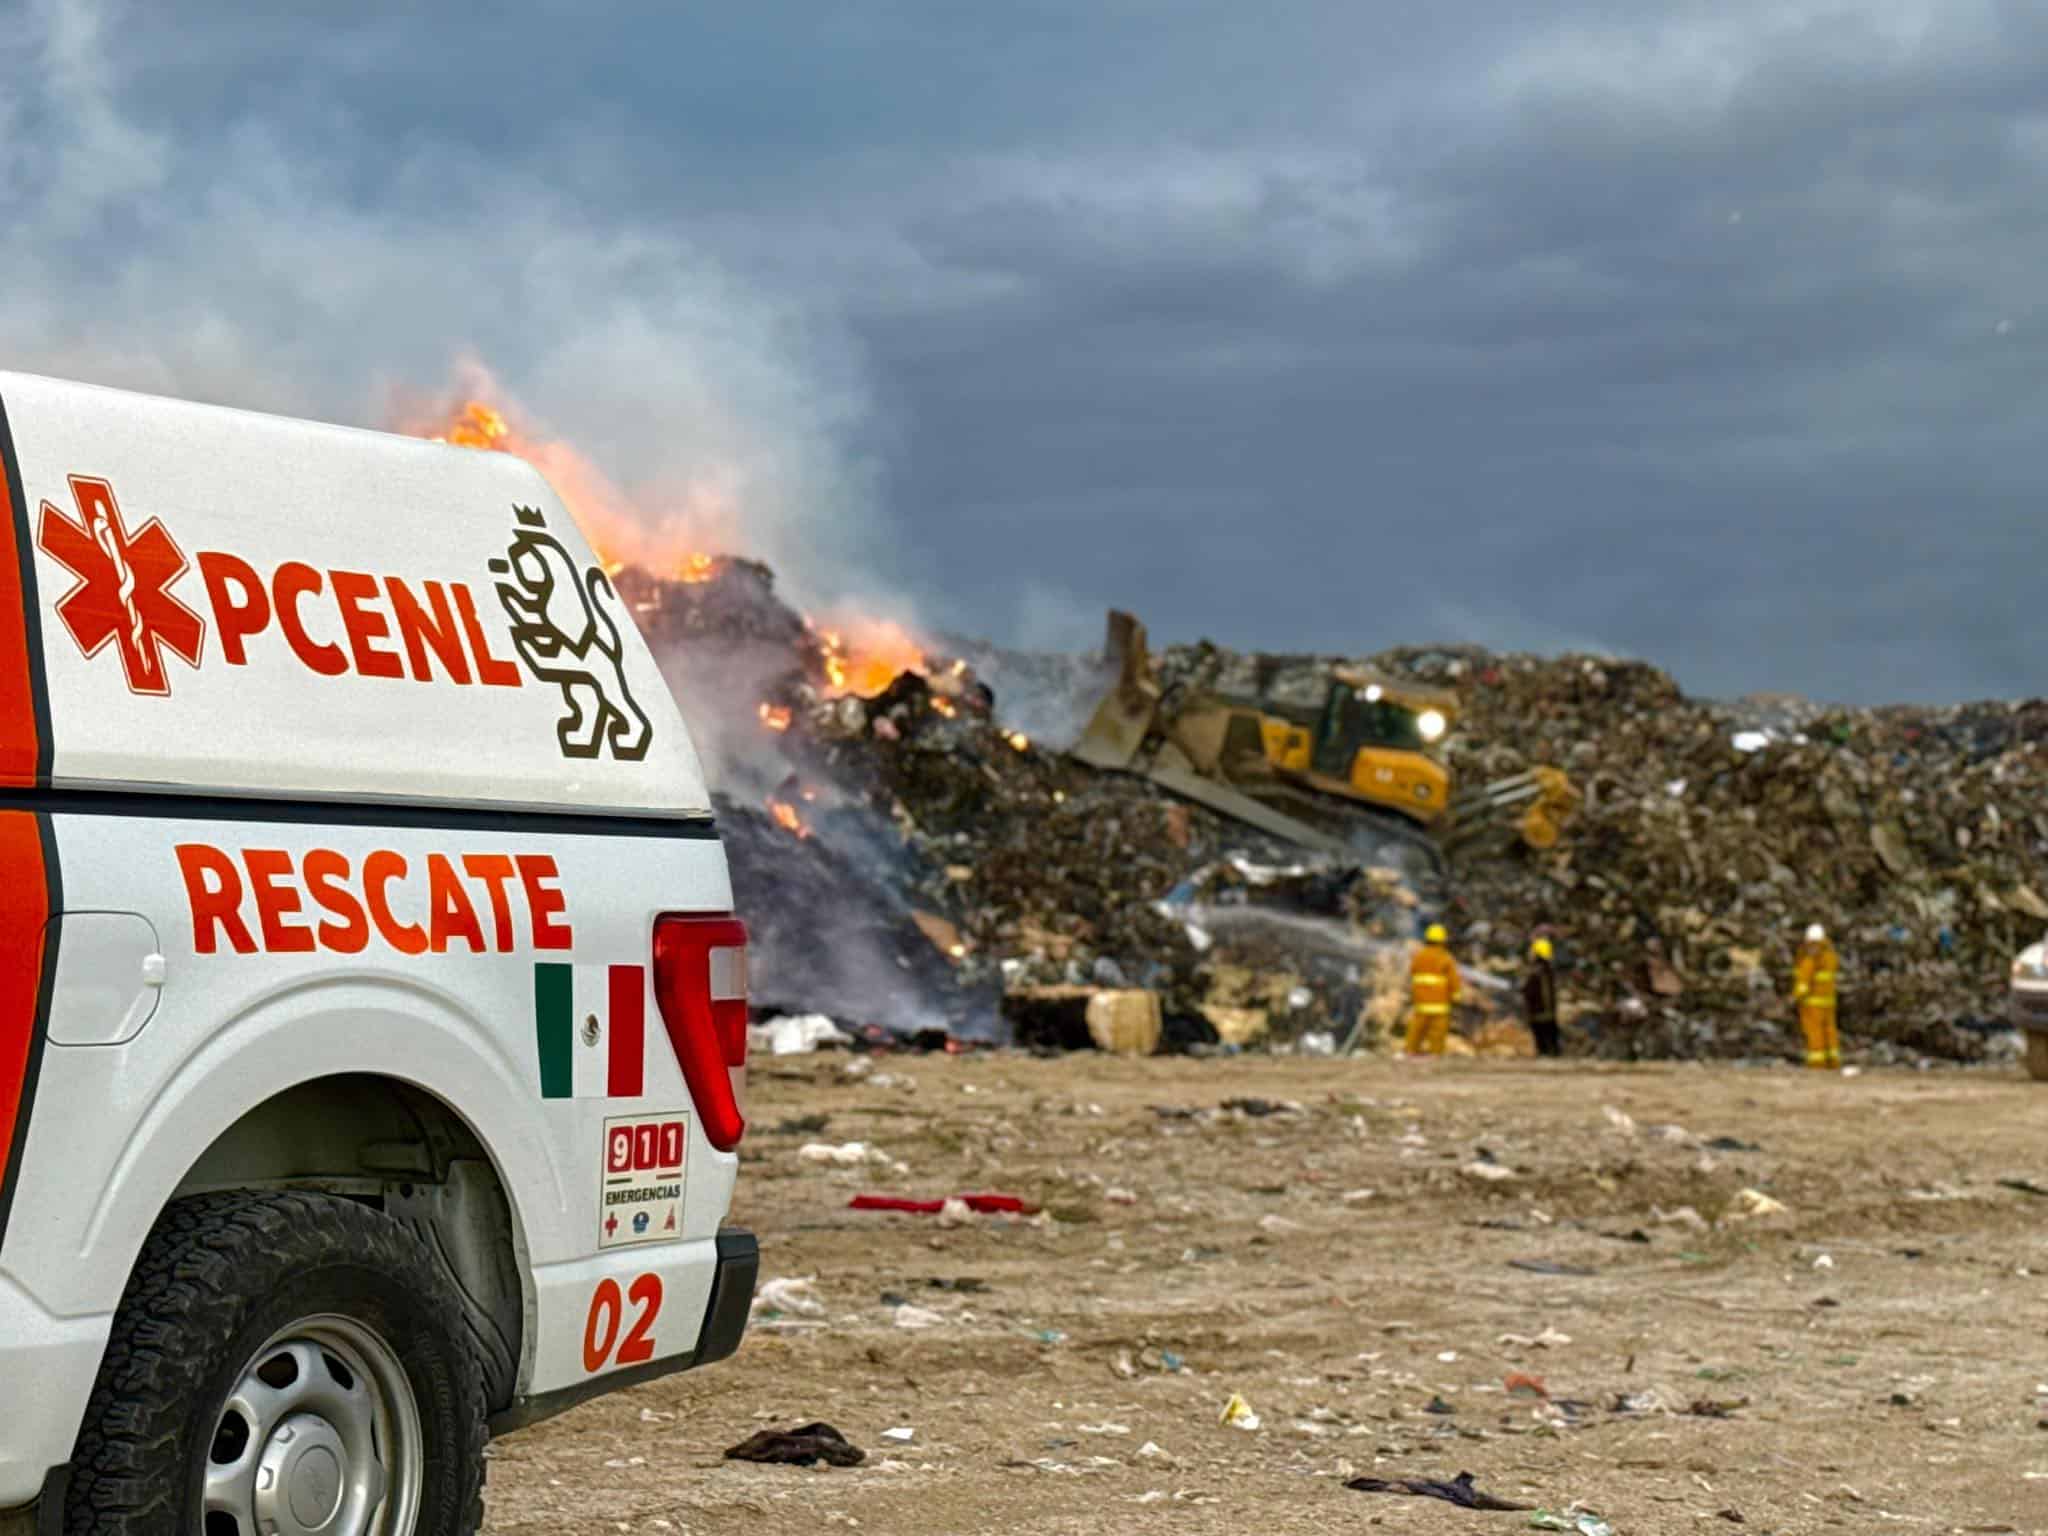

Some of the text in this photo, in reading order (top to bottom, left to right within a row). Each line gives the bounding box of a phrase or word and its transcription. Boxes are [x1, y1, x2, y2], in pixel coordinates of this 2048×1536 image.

[197, 552, 521, 687] PCENL
[175, 844, 572, 955] RESCATE
[605, 1184, 681, 1205] EMERGENCIAS
[610, 1125, 680, 1170] 911
[584, 1273, 663, 1371] 02
